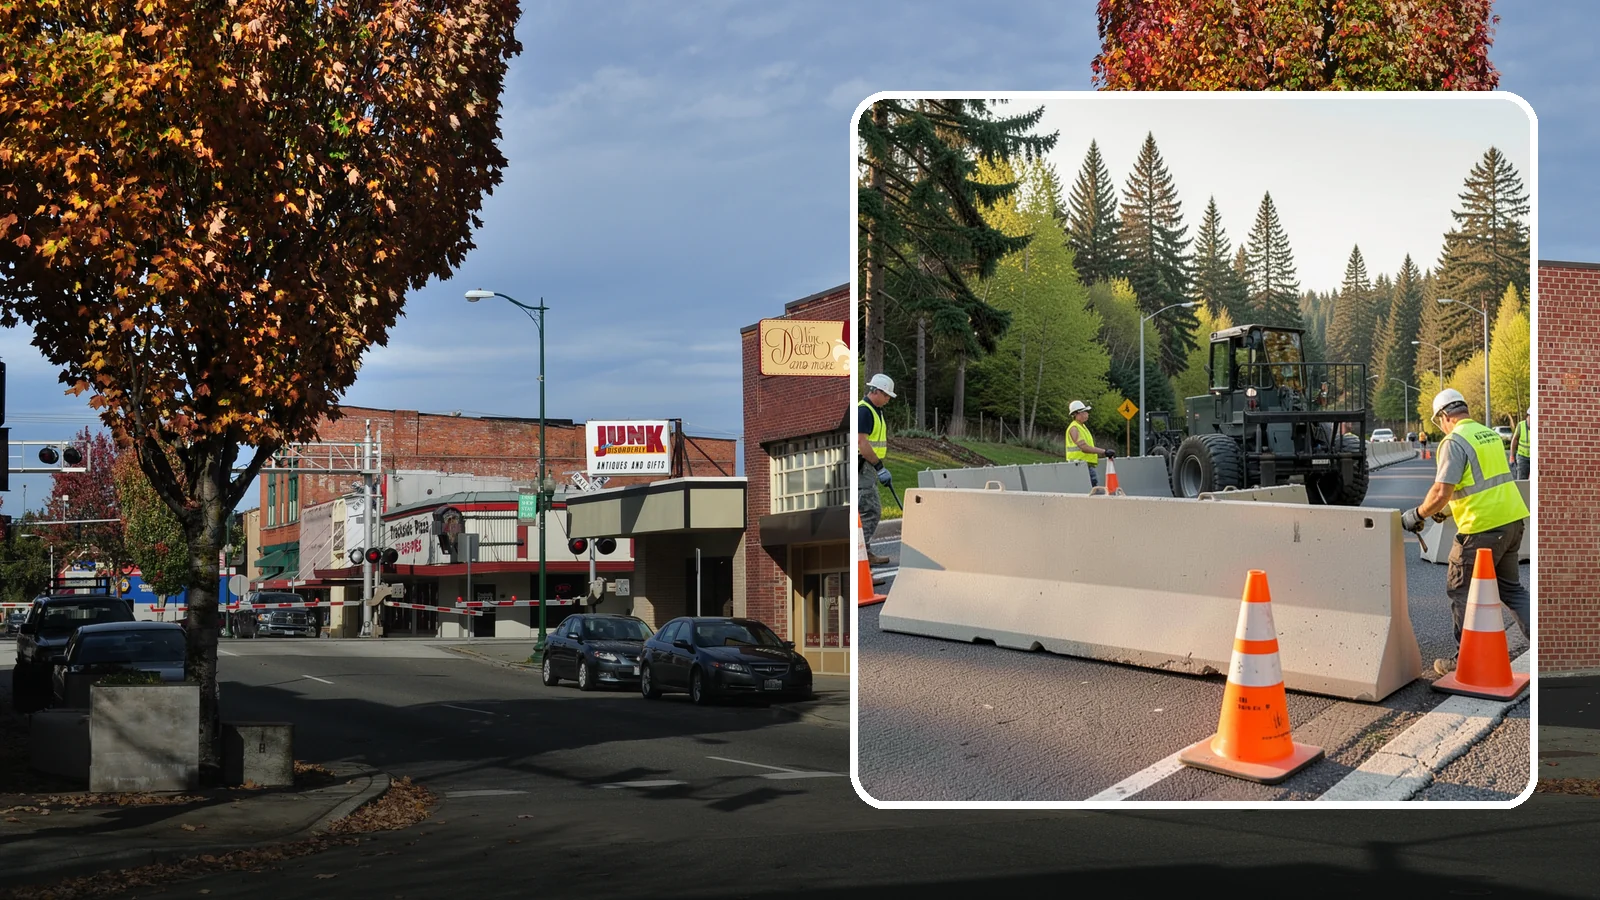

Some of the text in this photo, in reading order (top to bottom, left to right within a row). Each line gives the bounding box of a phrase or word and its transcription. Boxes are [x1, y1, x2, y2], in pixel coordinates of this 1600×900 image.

[595, 425, 665, 457] JUNK
[607, 446, 646, 454] DISORDERLY
[596, 460, 666, 470] ANTIQUES AND GIFTS
[390, 519, 429, 539] Trackside Pizza
